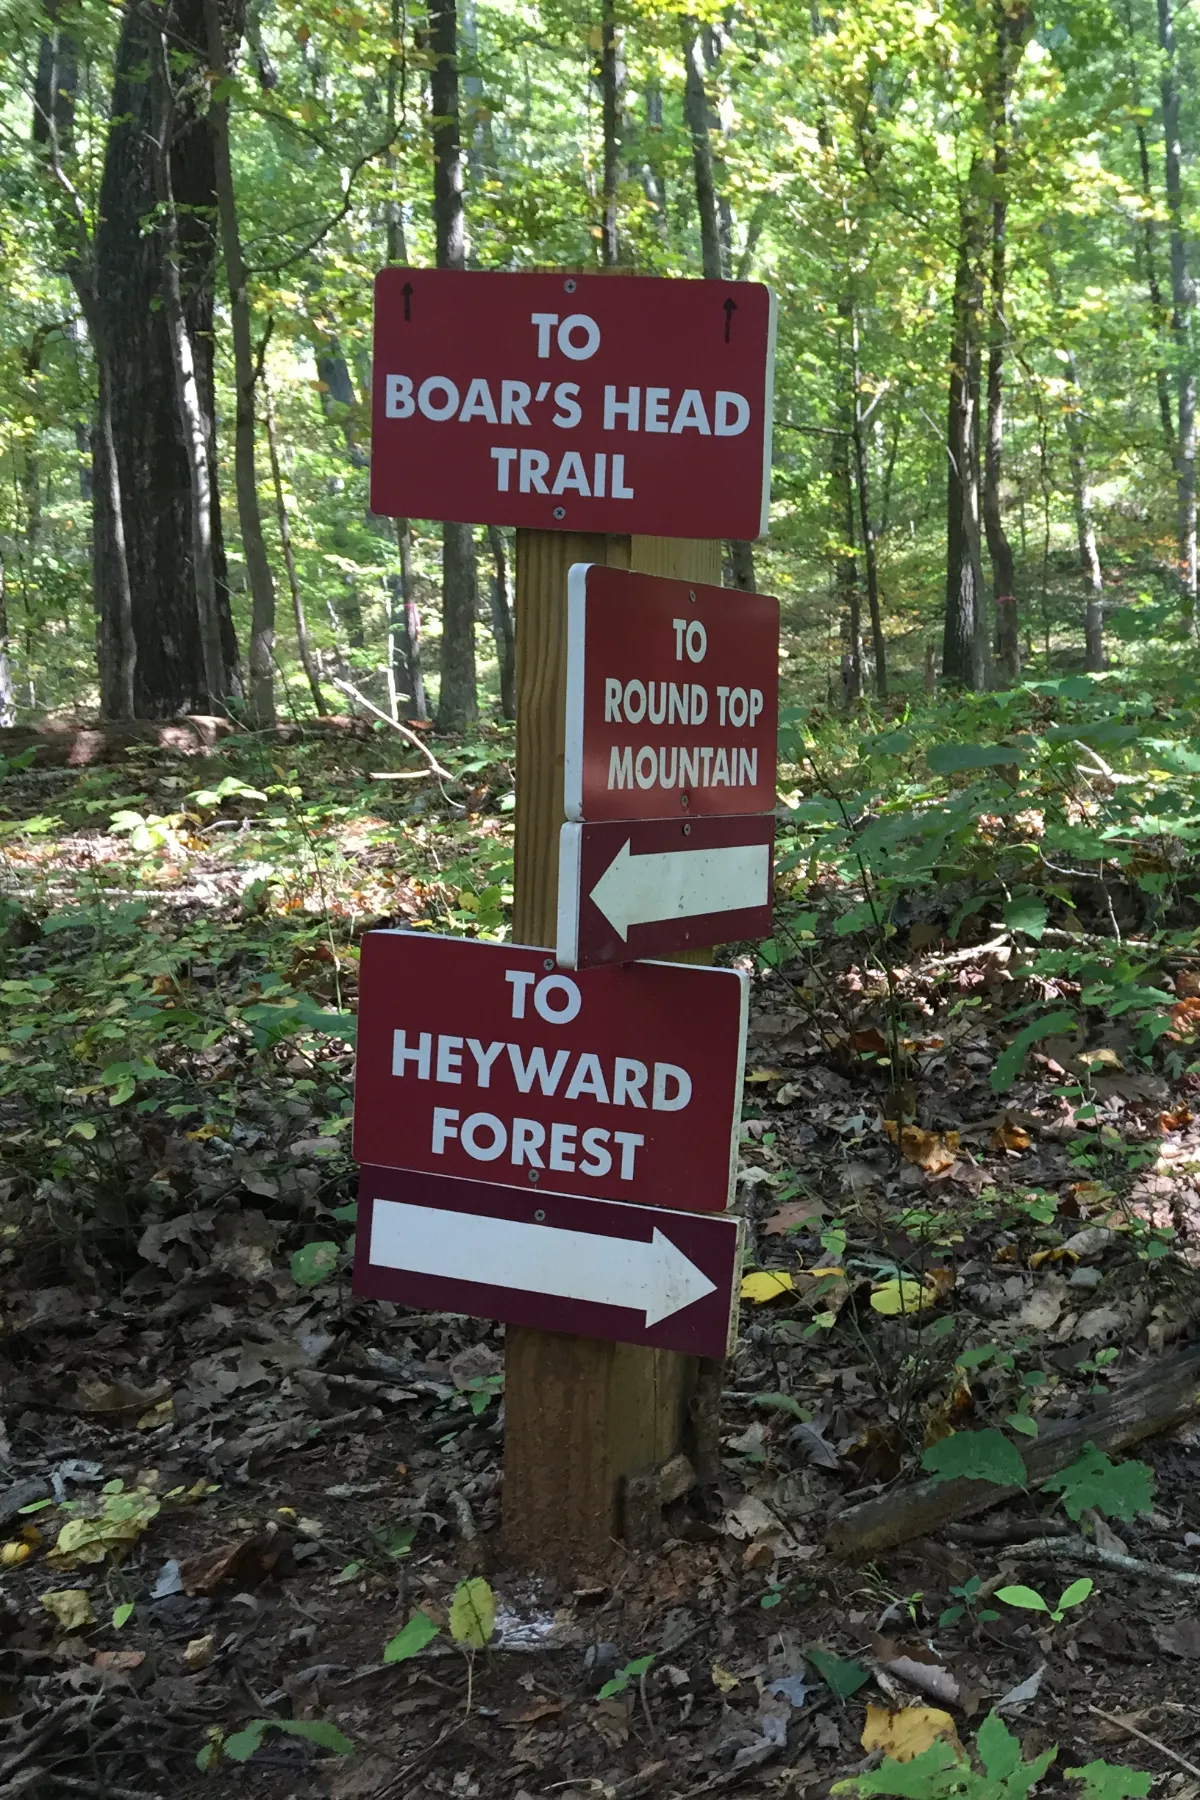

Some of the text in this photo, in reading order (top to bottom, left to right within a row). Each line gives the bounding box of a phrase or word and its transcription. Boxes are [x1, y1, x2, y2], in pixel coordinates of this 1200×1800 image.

[531, 312, 601, 361] TO
[385, 374, 751, 437] BOAR'S HEAD
[490, 446, 635, 501] TRAIL
[672, 618, 707, 663] TO
[603, 677, 764, 727] ROUND TOP
[607, 744, 758, 792] MOUNTAIN
[504, 969, 582, 1025] TO
[391, 1028, 692, 1112] HEYWARD
[431, 1106, 645, 1181] FOREST
